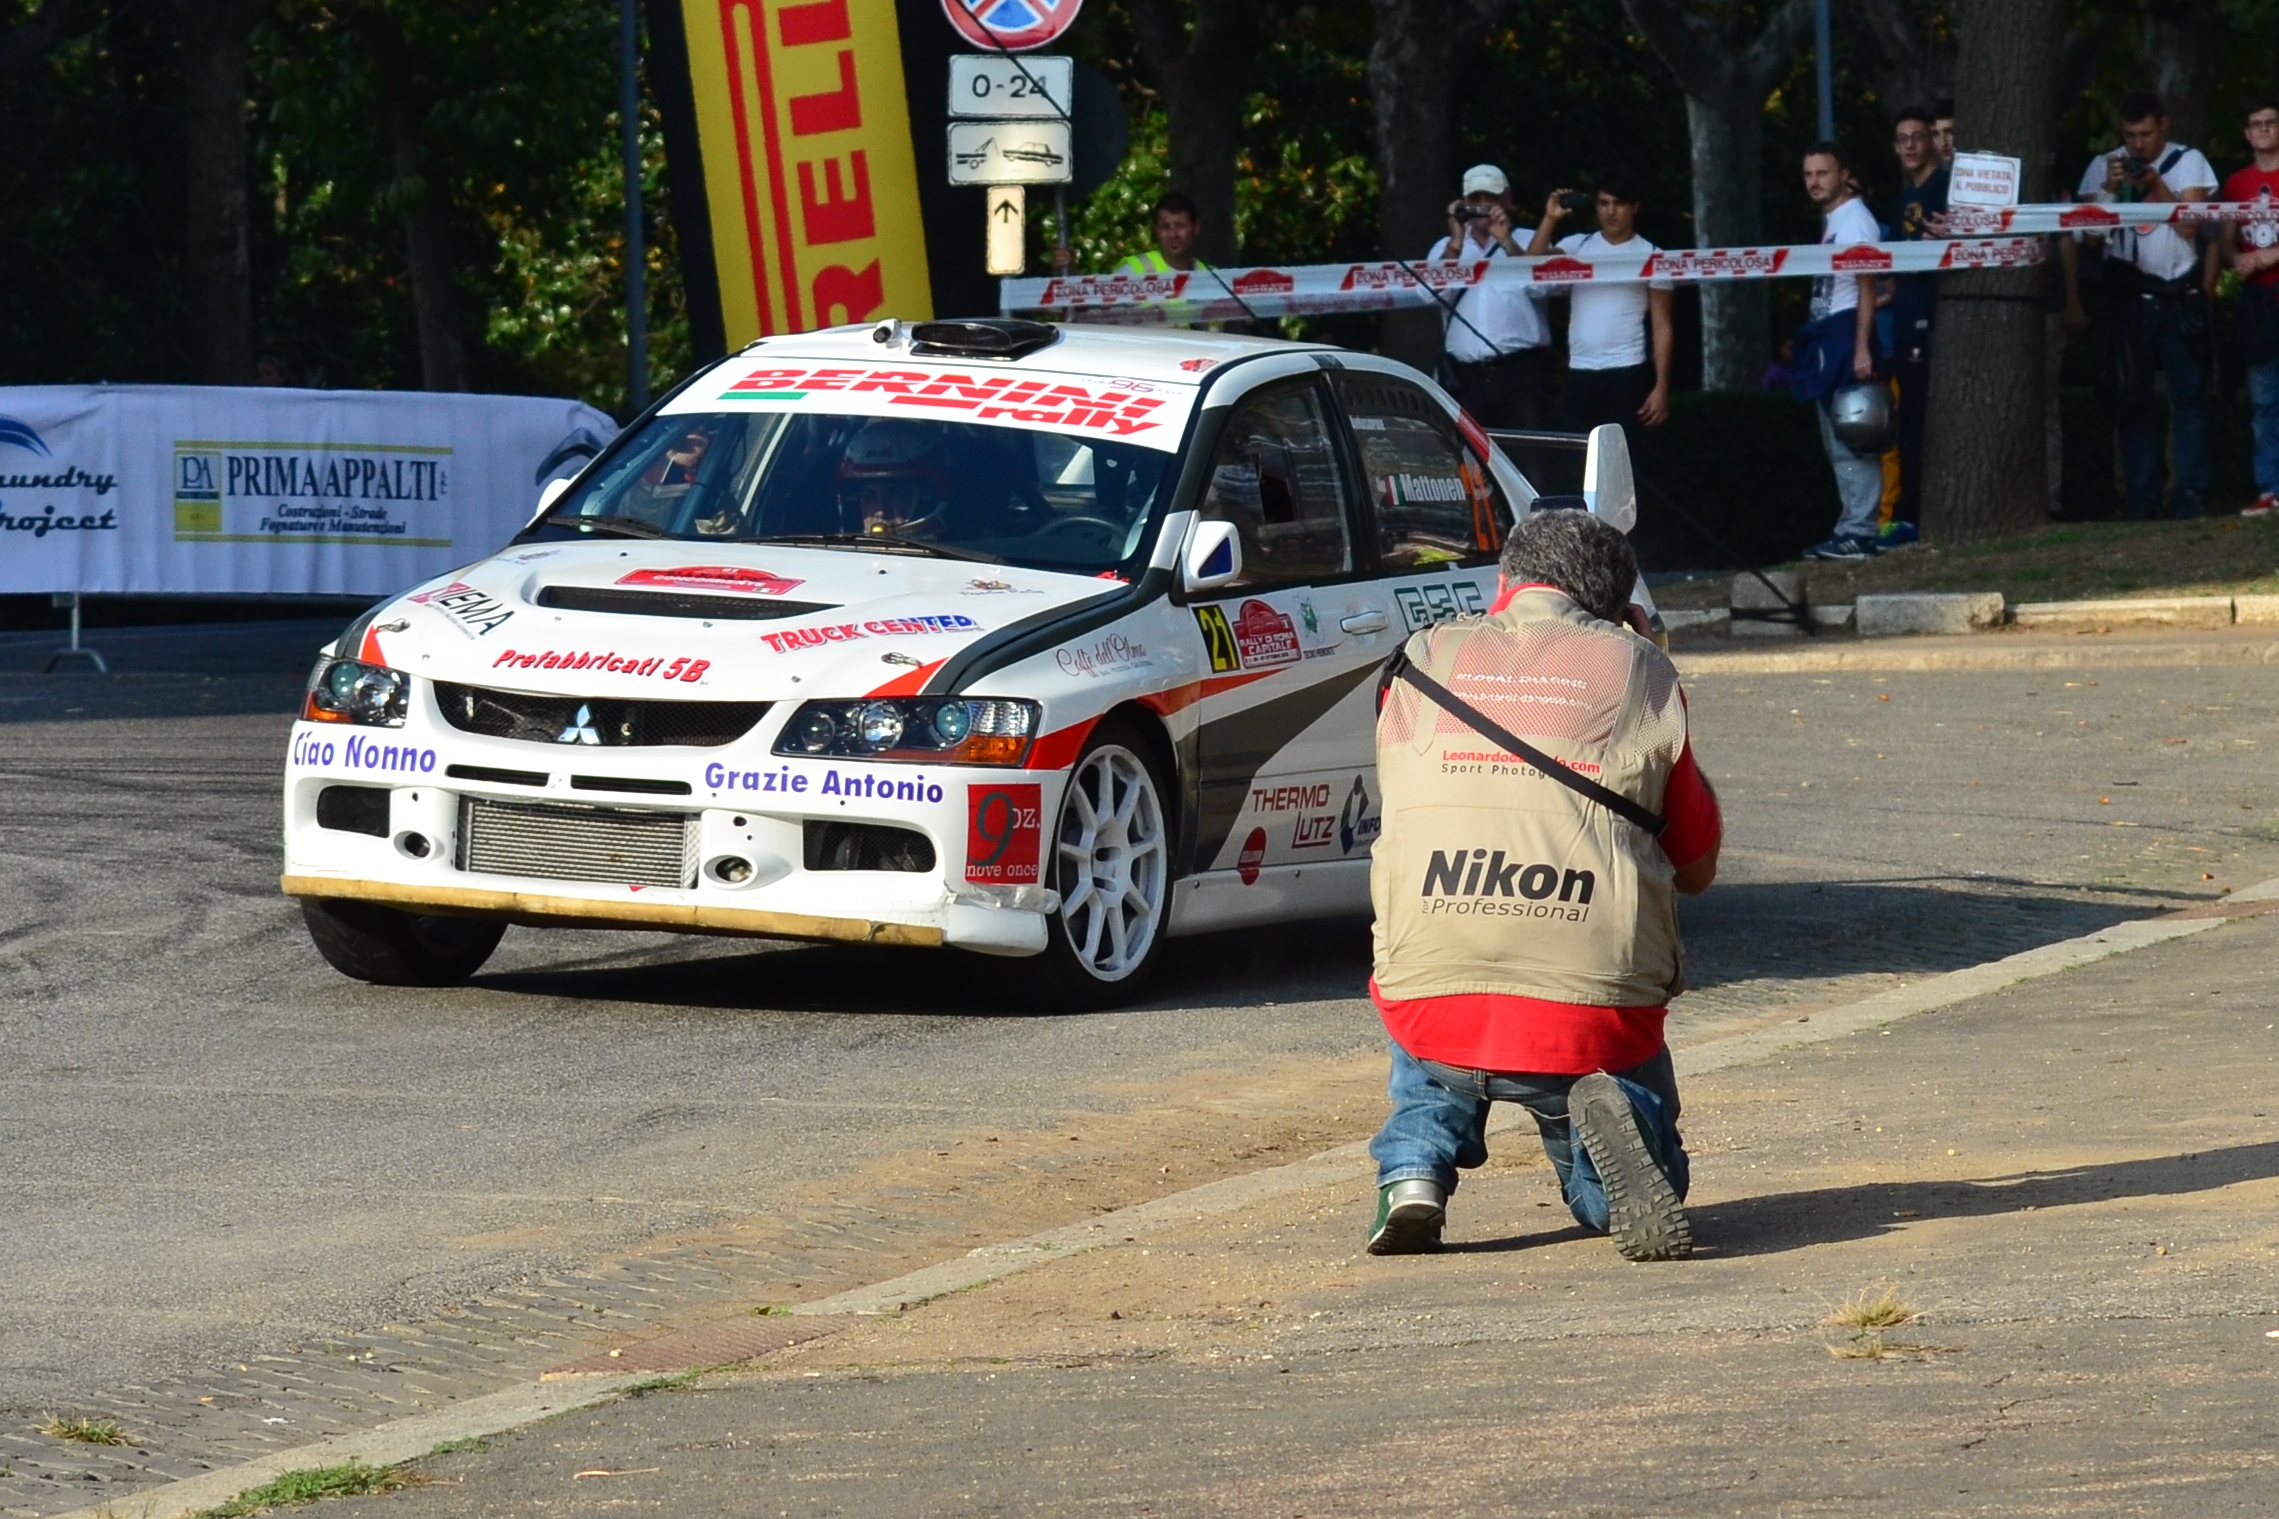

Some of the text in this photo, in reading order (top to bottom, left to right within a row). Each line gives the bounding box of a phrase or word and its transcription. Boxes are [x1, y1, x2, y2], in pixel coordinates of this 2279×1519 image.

[1655, 256, 1772, 271] ZONA PERICOLOSA
[1954, 248, 1987, 261] ZONA
[1055, 280, 1174, 298] ZONA PERICOLOSA
[1355, 270, 1389, 283] ZONA
[728, 369, 1167, 418] BERNINI
[977, 407, 1163, 435] rally
[0, 466, 117, 495] undry
[761, 624, 864, 653] TRUCK
[1248, 639, 1293, 655] CAPITALE
[492, 650, 665, 677] Prefabbricati
[663, 657, 711, 683] 5B
[294, 731, 436, 772] Ciao Nonno
[705, 762, 944, 803] Grazie Antonio
[1441, 764, 1483, 775] Sport
[1253, 784, 1330, 812] THERMO
[1291, 811, 1336, 848] LUTZ
[966, 864, 1038, 877] nove once
[1422, 848, 1596, 905] Nikon
[1431, 898, 1590, 922] Professional
